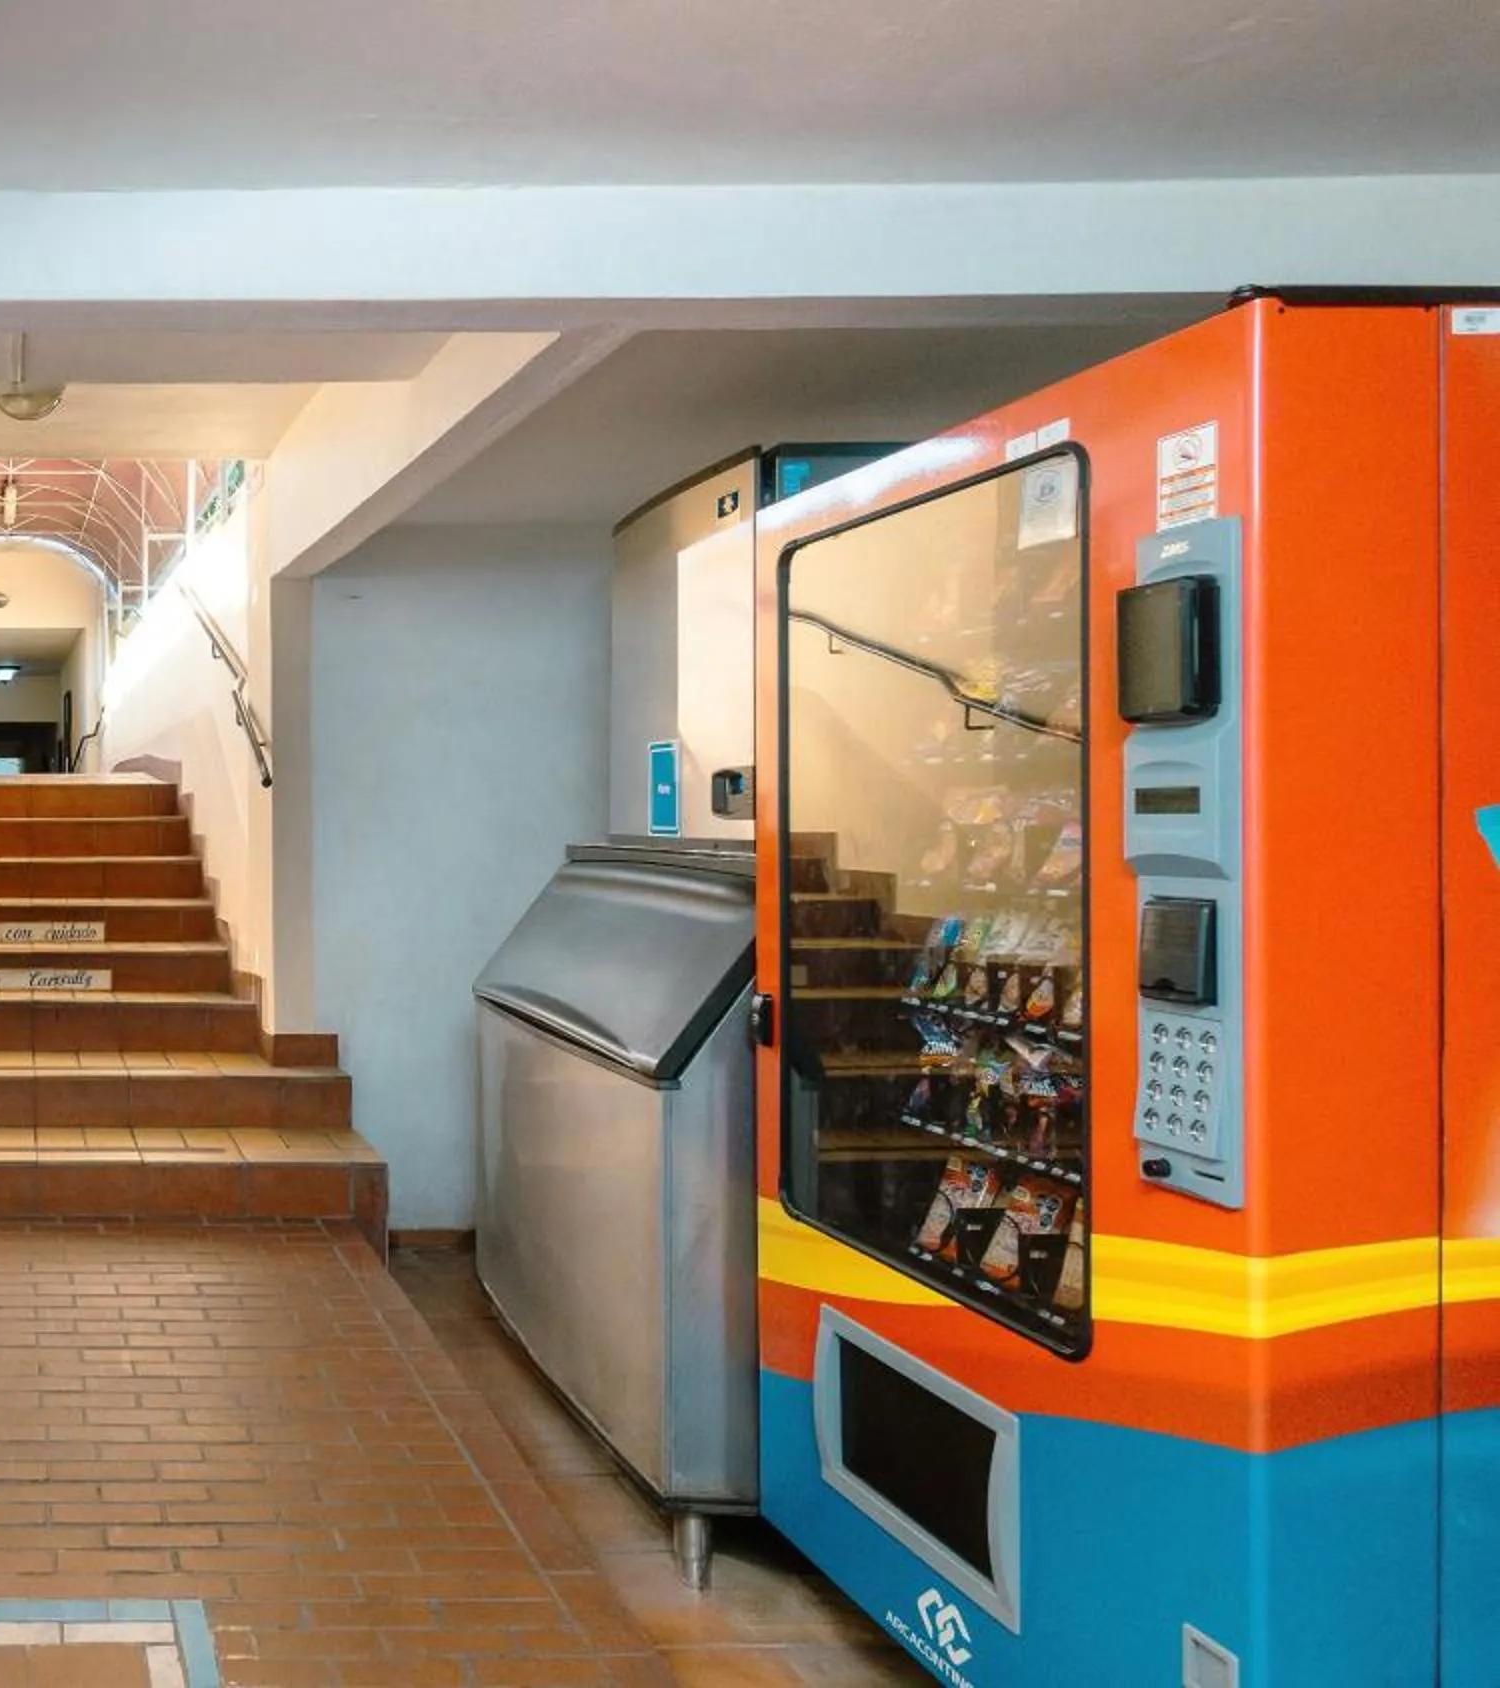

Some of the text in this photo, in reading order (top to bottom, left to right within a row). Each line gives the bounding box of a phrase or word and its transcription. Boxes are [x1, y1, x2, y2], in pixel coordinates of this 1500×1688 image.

[3, 928, 33, 941] con
[44, 922, 98, 942] cuidado
[28, 970, 94, 988] Carefully
